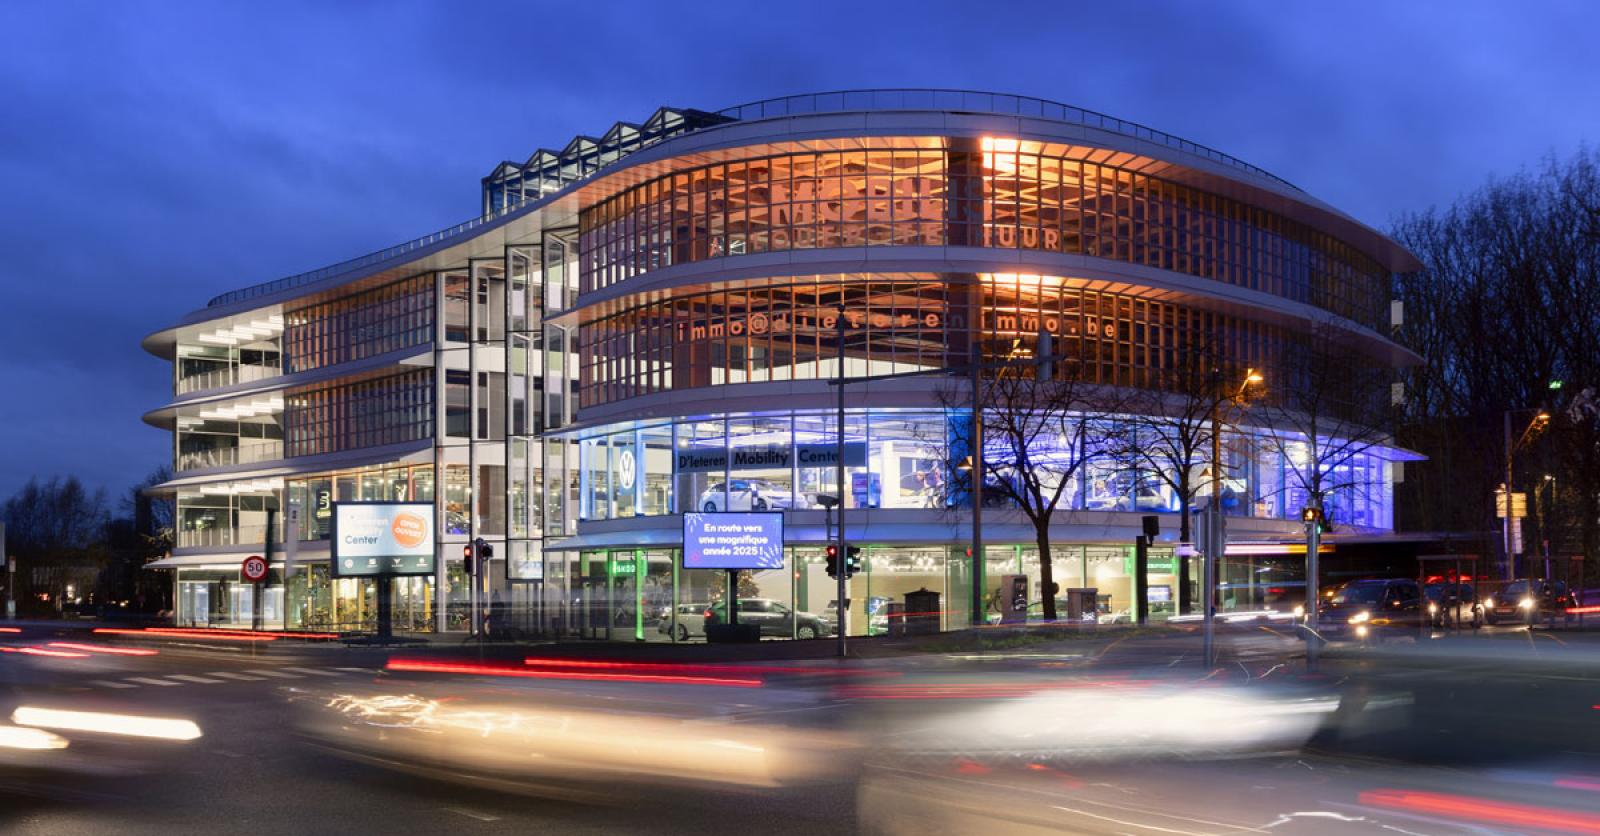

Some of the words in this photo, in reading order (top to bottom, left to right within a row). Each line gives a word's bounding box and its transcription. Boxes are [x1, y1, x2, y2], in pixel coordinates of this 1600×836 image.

[680, 454, 725, 468] D'Ieteren
[735, 450, 788, 466] Mobility
[800, 450, 840, 462] Cente
[704, 524, 716, 532] En
[718, 524, 741, 532] route
[345, 536, 378, 544] Center
[703, 546, 731, 555] année
[733, 546, 758, 555] 2025
[248, 562, 262, 572] 50
